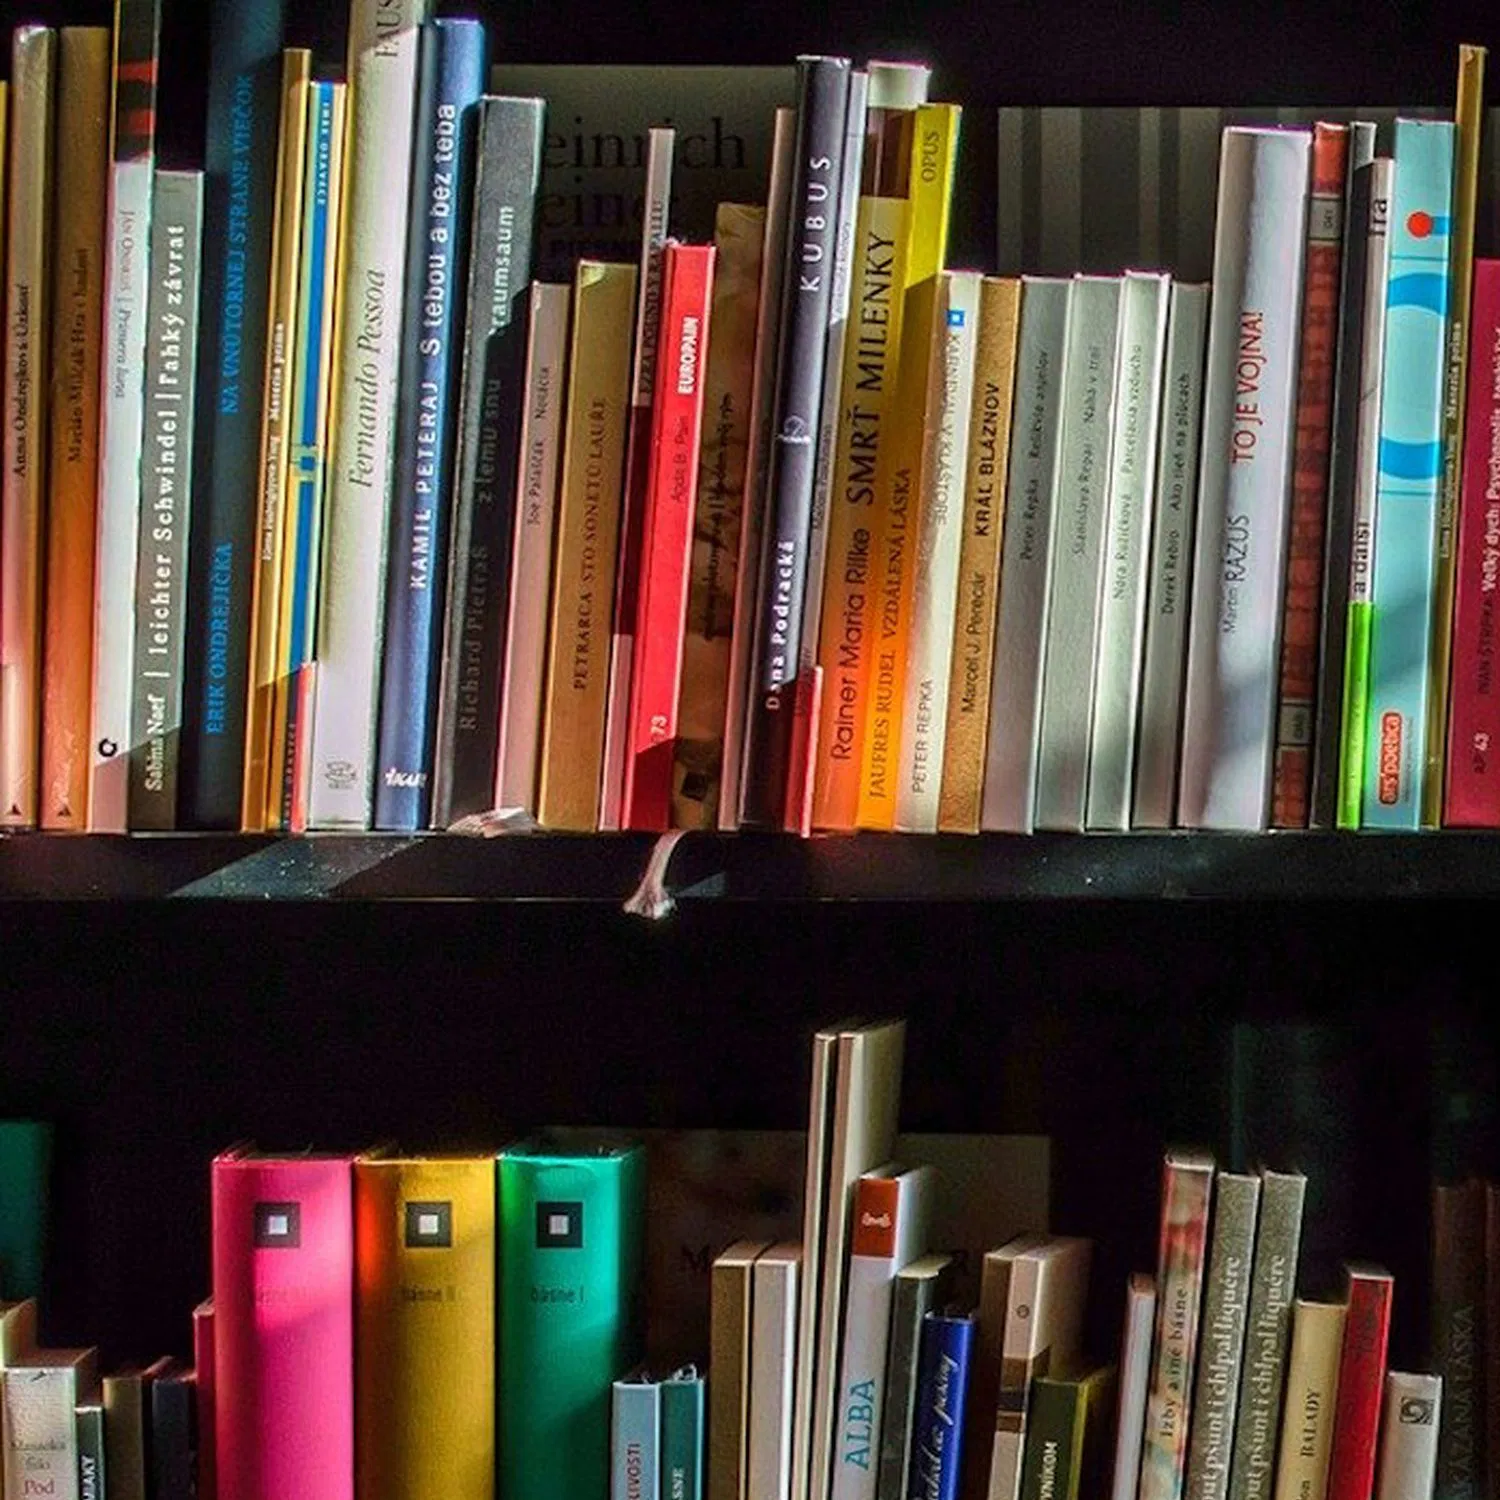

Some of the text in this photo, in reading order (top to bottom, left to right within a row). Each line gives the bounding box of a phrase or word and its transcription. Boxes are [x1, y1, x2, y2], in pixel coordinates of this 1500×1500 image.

[163, 225, 184, 304] závrat
[801, 156, 830, 291] KUBUS
[348, 270, 386, 488] Fernando Pessoa
[410, 104, 455, 587] KAMIL PETERAJ S tebou a bez teba
[678, 317, 699, 394] EUROPAIN
[153, 409, 177, 541] Schwindel
[831, 231, 895, 760] Rainer Maria Rilke SMRŤ MILENKY
[150, 554, 172, 654] leichter
[765, 541, 795, 709] Dana Podracká
[148, 693, 166, 734] Naef
[146, 738, 164, 790] Sabina
[844, 1378, 876, 1471] ALBA
[1244, 1411, 1270, 1468] pšunt
